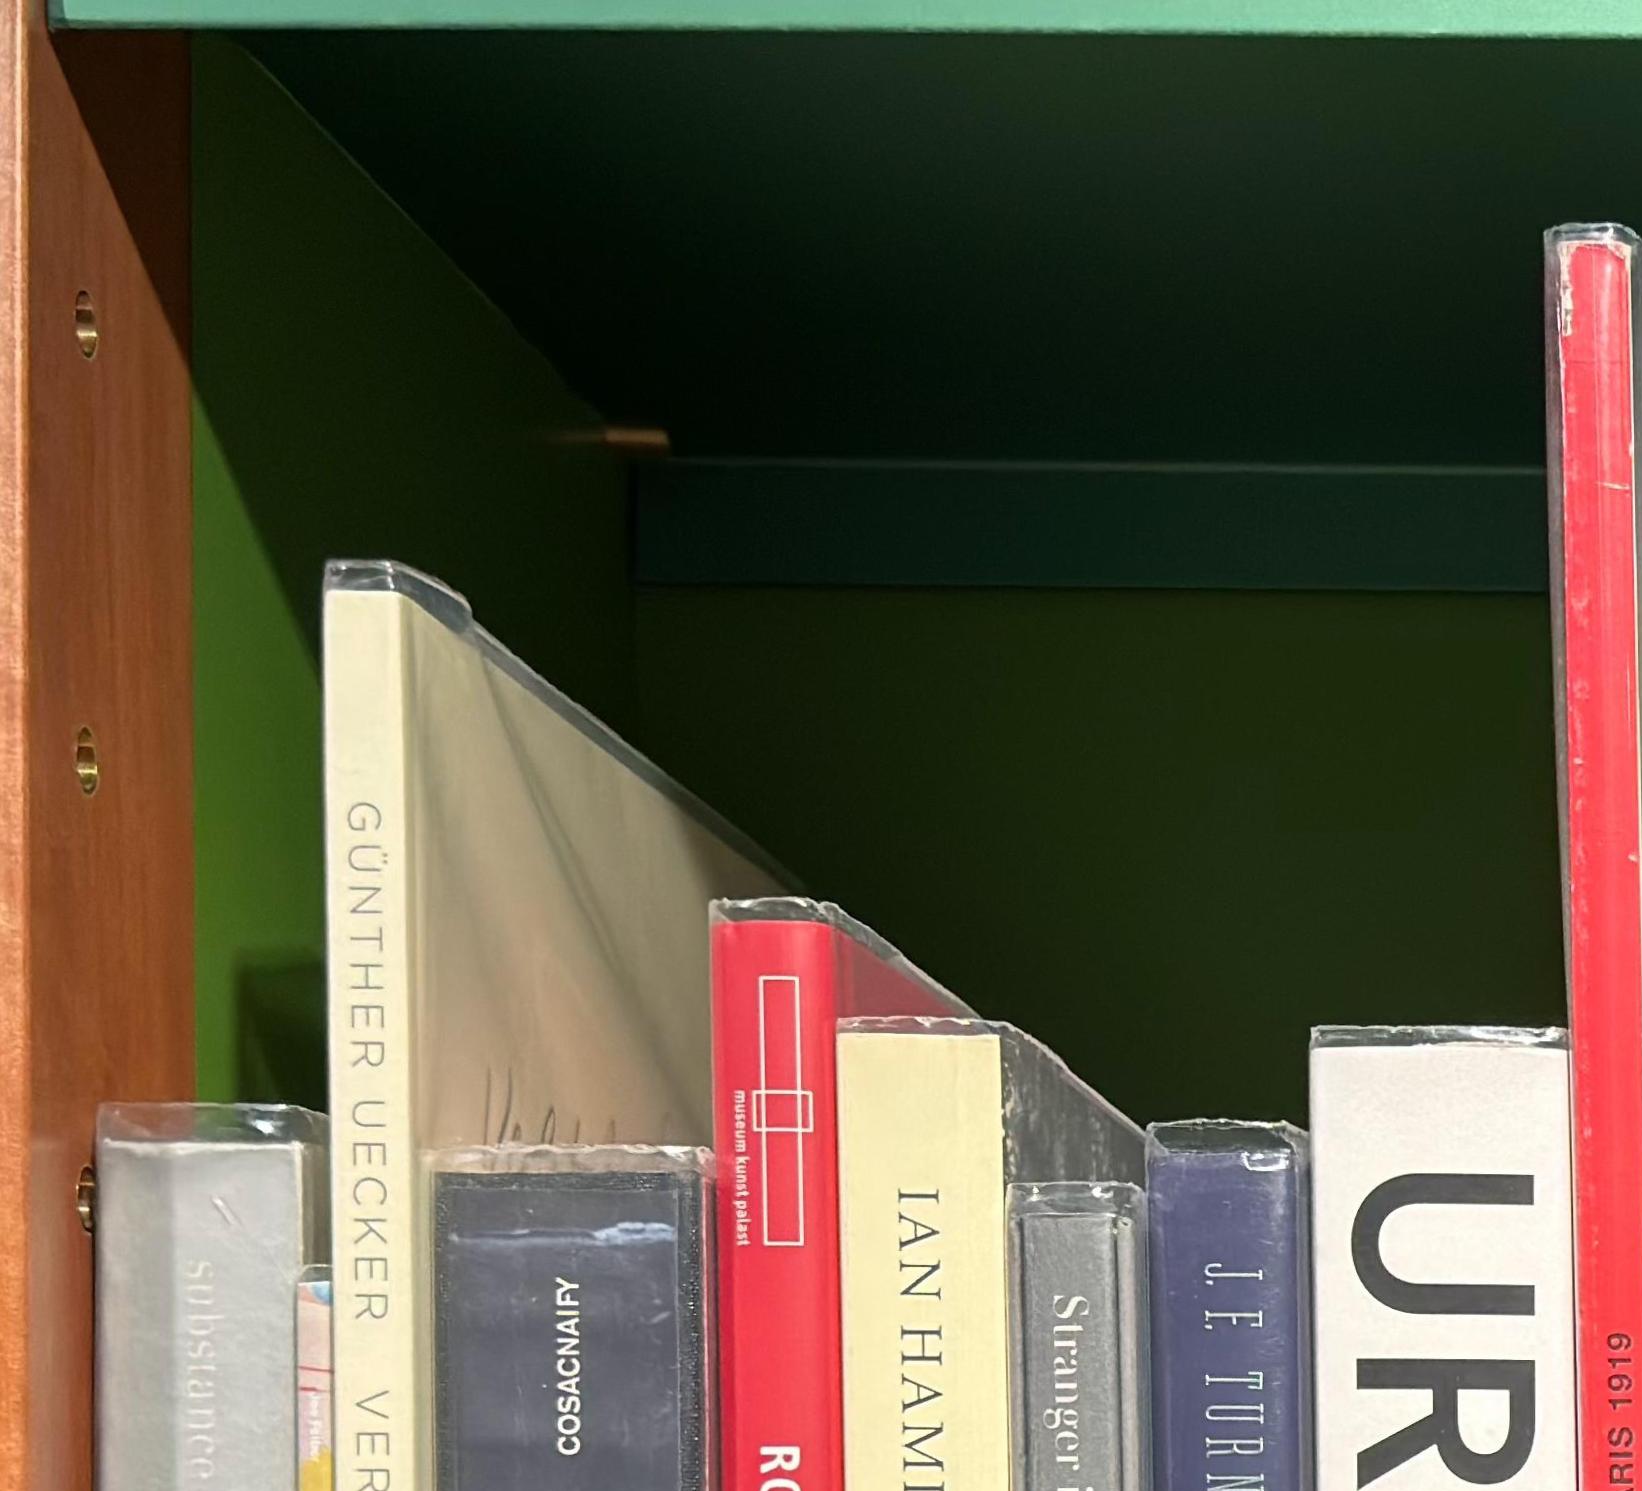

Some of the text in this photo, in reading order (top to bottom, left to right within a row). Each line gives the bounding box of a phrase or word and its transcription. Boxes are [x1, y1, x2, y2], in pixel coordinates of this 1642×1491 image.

[347, 802, 388, 1068] GÜNTHER
[351, 1101, 390, 1321] UECKER
[733, 1090, 752, 1246] museum kunst palast
[899, 1189, 941, 1302] IAN
[185, 1260, 223, 1480] substance
[554, 1277, 581, 1457] COSACNAIFY
[1045, 1294, 1090, 1474] Stranger
[1608, 1332, 1634, 1412] 1919
